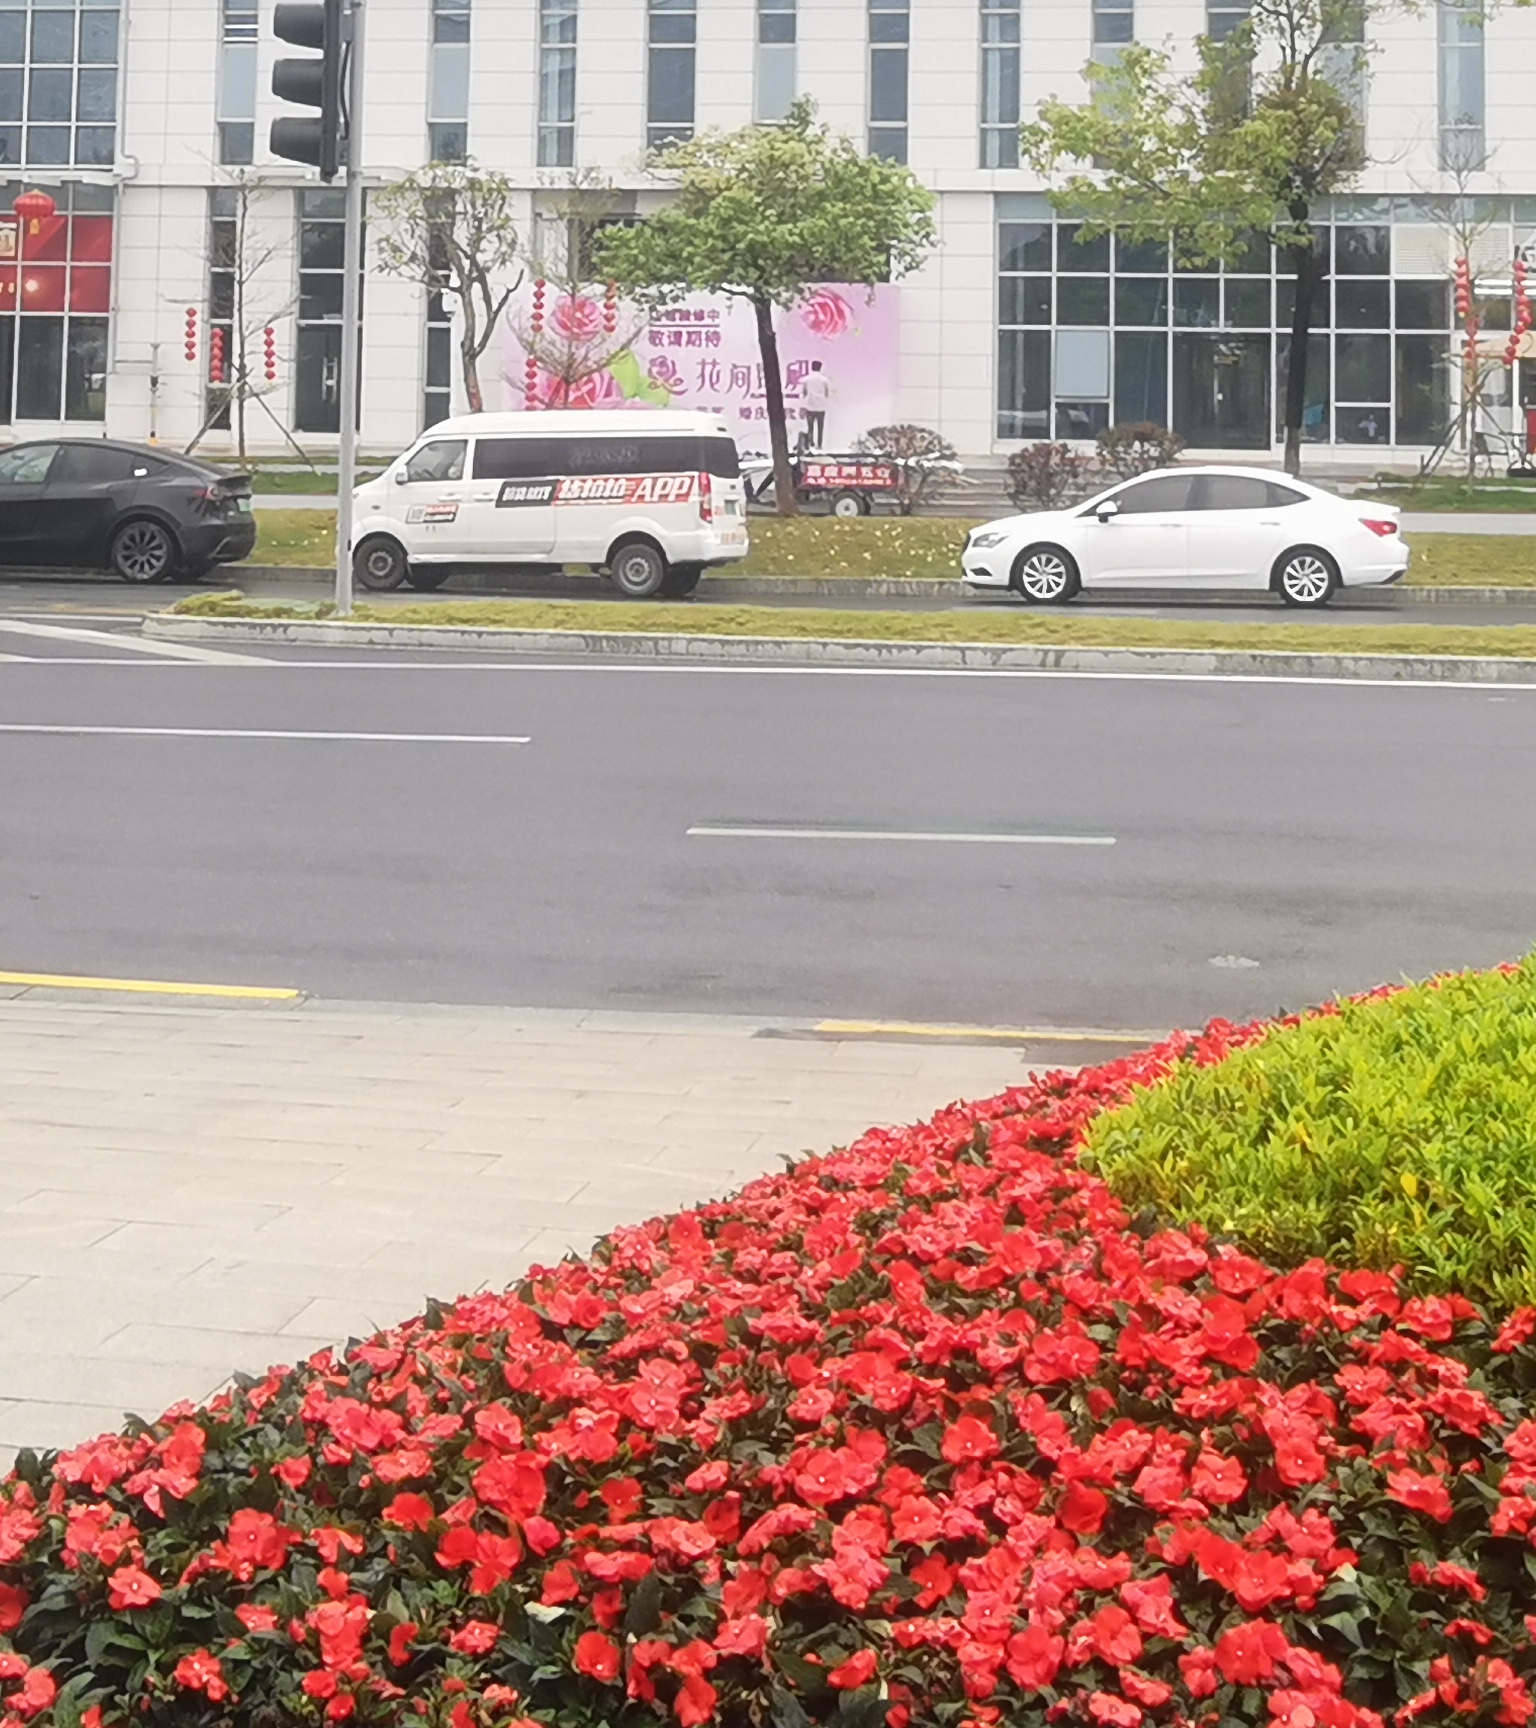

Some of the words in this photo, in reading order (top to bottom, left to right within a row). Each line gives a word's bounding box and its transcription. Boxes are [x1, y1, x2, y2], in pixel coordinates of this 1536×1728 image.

[647, 329, 722, 348] 敬请期待
[631, 476, 692, 503] APP
